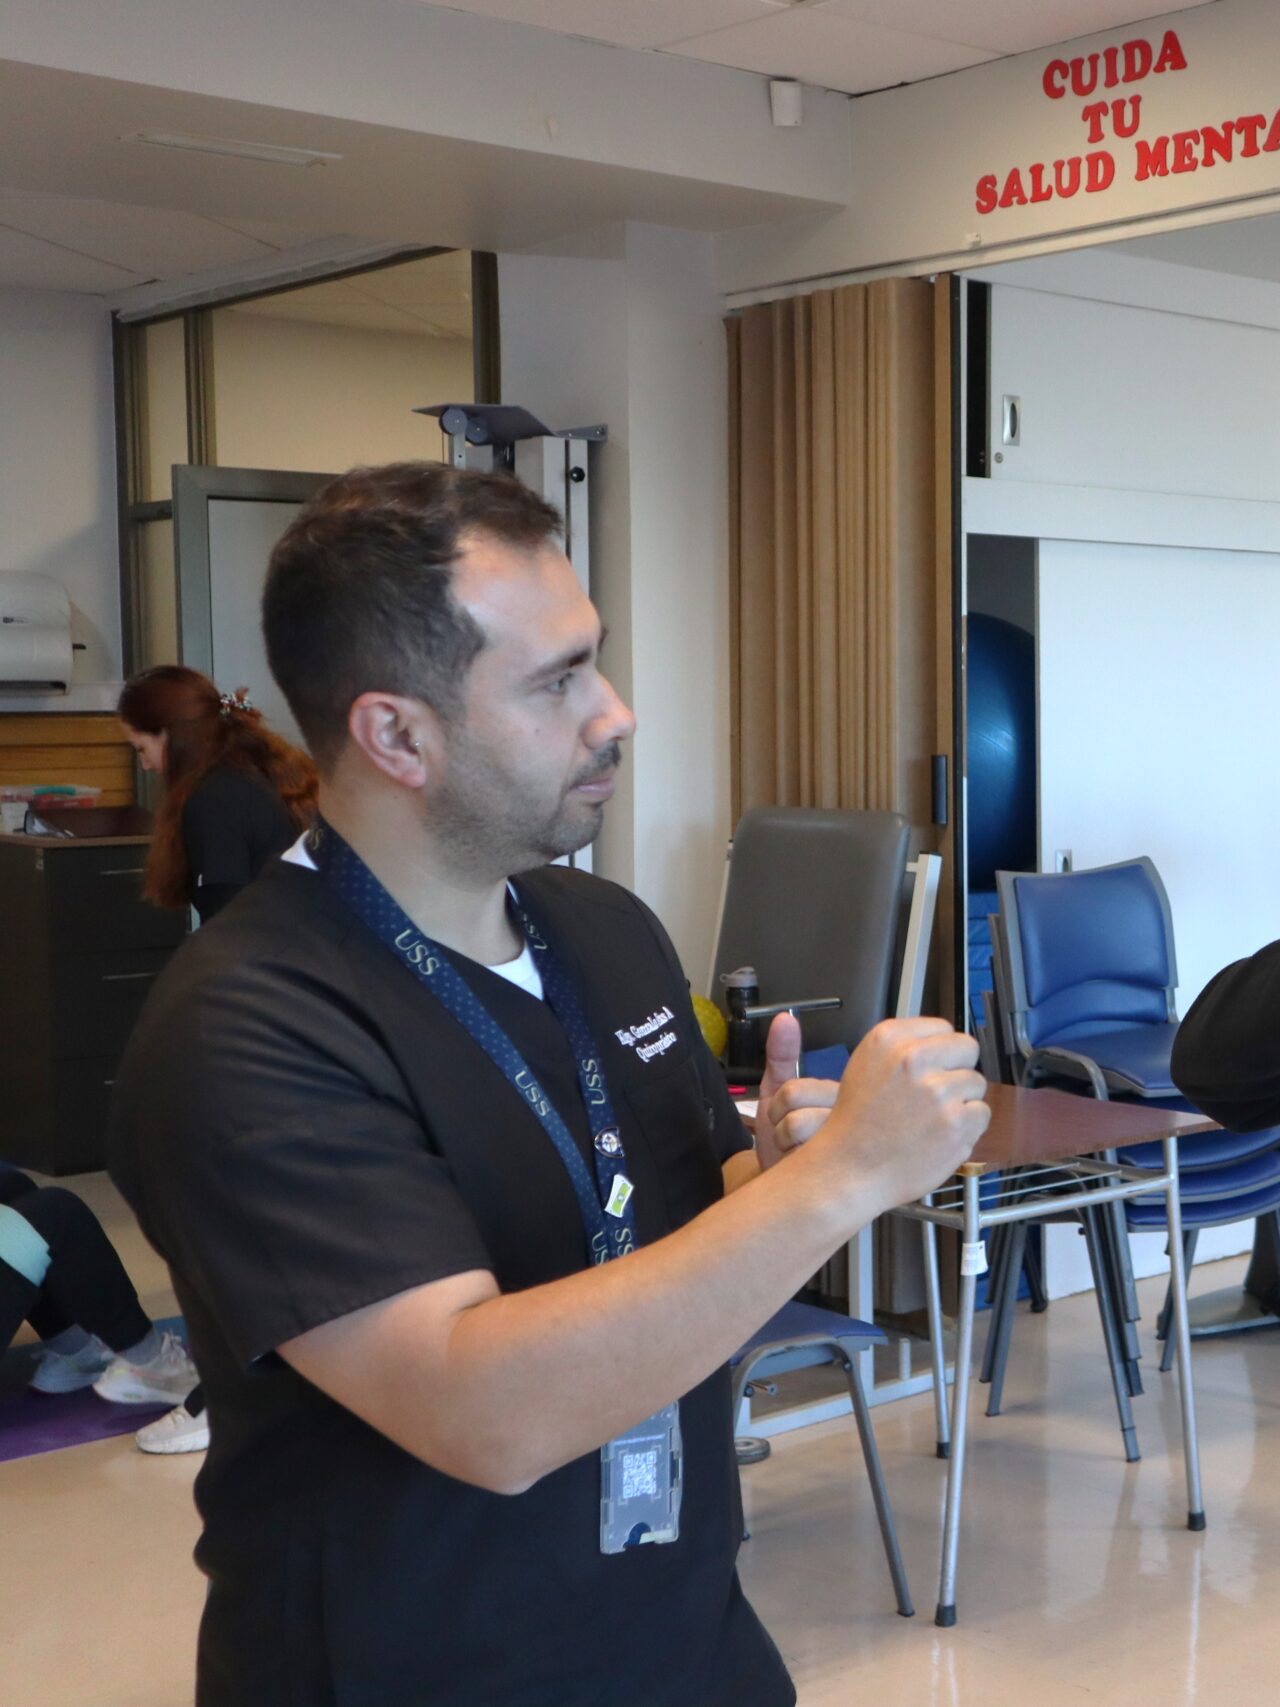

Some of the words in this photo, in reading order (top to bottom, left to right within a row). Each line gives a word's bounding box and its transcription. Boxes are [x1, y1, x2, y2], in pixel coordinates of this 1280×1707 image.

[1042, 30, 1188, 99] CUIDA
[1082, 95, 1142, 144] TU
[975, 151, 1116, 215] SALUD
[394, 929, 440, 976] USS
[514, 1070, 551, 1118] USS
[581, 1058, 607, 1106] USS
